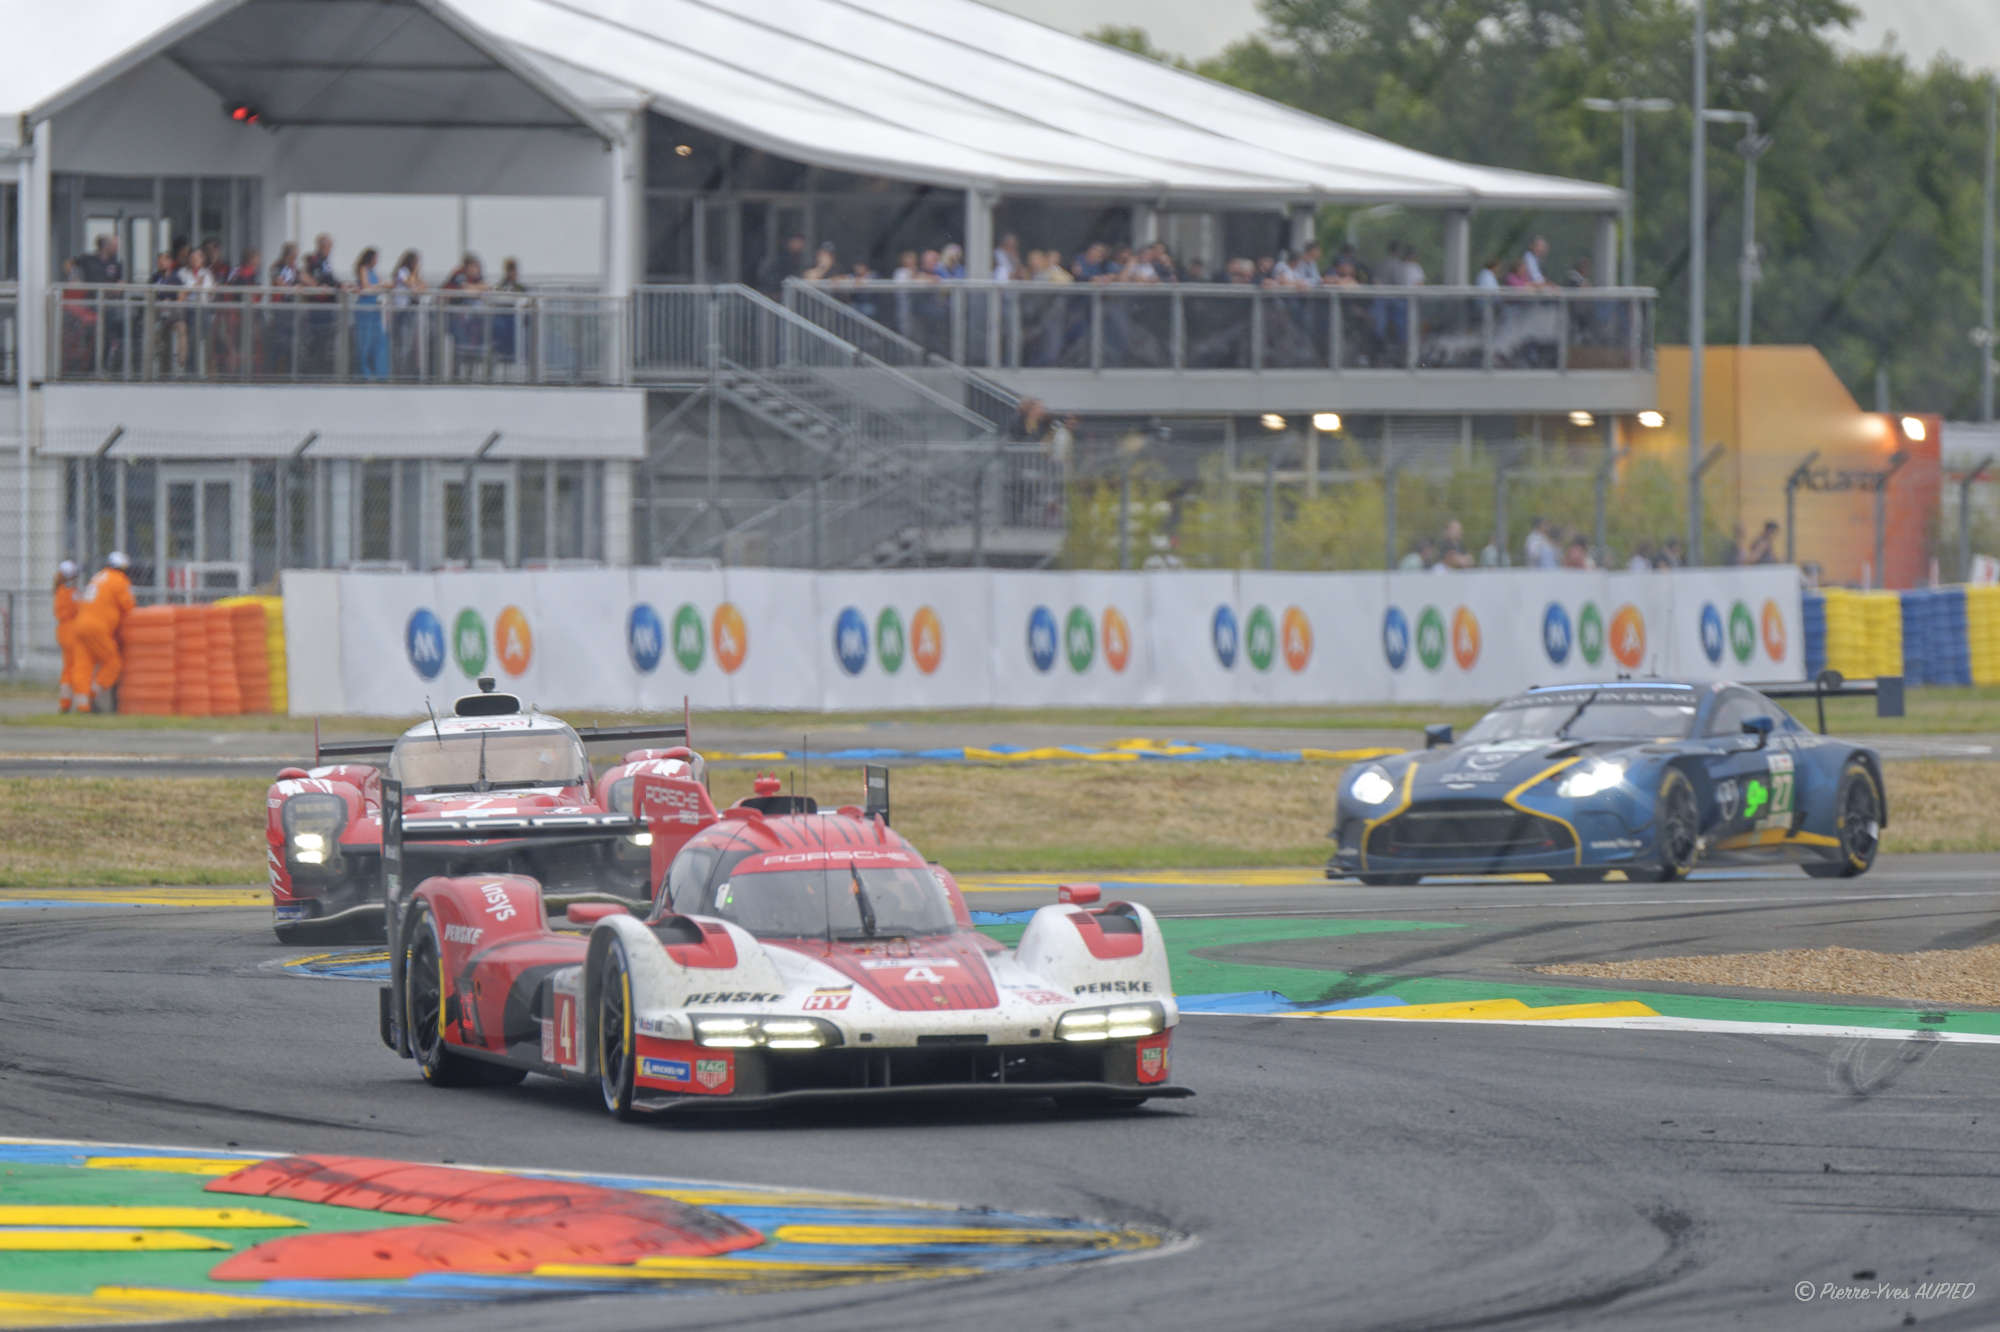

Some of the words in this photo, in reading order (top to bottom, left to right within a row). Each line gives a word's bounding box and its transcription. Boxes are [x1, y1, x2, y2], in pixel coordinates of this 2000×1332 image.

[645, 785, 699, 810] PORSCHE
[763, 850, 911, 867] PORSCHE
[443, 923, 484, 945] PENSKE
[903, 966, 945, 985] 4
[1073, 979, 1154, 996] PENSKE
[682, 991, 786, 1008] PENSKE
[805, 995, 845, 1011] HY
[559, 999, 572, 1061] 4
[698, 1061, 725, 1073] TAG
